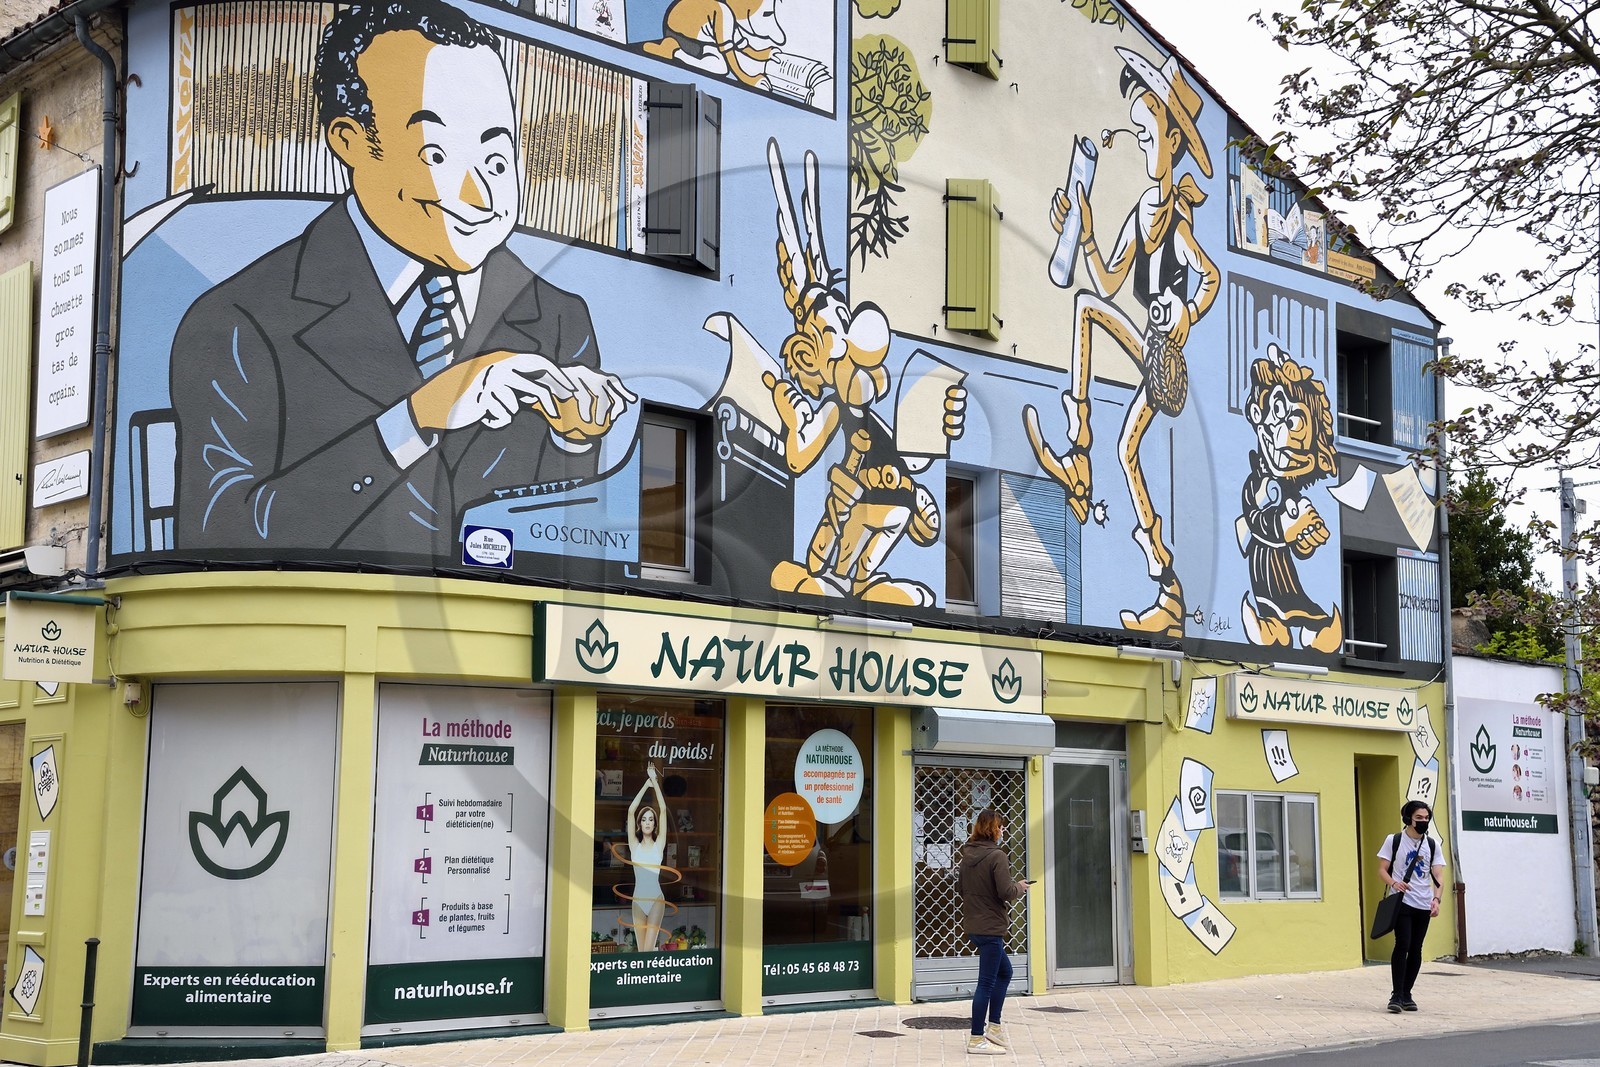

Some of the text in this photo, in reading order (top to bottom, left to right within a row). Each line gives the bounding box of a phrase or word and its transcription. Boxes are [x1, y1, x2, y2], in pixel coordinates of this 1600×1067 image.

[61, 208, 78, 226] Nous
[53, 231, 84, 257] sommes
[53, 262, 83, 288] tous un
[51, 292, 83, 318] chouette
[55, 326, 75, 348] gros
[52, 353, 78, 374] tas de
[48, 384, 79, 405] copains.
[530, 523, 630, 549] GOSCINNY
[483, 543, 506, 551] MICHELET
[14, 644, 87, 656] NATUR HOUSE
[52, 658, 81, 666] Diététique
[650, 631, 969, 698] NATUR HOUSE
[1263, 690, 1390, 720] NATUR HOUSE
[616, 709, 632, 732] je
[634, 712, 675, 733] perds
[1513, 714, 1541, 726] La méthode
[423, 718, 512, 739] La méthode
[1515, 727, 1540, 737] Naturhouse
[428, 747, 509, 763] Naturhouse
[648, 741, 714, 764] du poids!
[806, 754, 852, 765] NATURHOUSE
[803, 770, 856, 779] accompagnée par
[814, 783, 854, 792] professionnel
[439, 799, 503, 808] Suivi hebdomadaire
[826, 795, 842, 804] santé
[421, 808, 430, 818] 1.
[455, 810, 486, 818] par votre
[446, 819, 494, 829] diététicien(ne)
[1484, 815, 1538, 828] naturhouse.fr
[419, 861, 427, 870] 2.
[444, 856, 494, 865] Plan diététique
[447, 866, 491, 874] Personnalisé
[442, 903, 470, 911] Produits
[477, 902, 493, 910] base
[417, 913, 426, 922] 3.
[439, 912, 495, 923] de plantes, fruits
[448, 924, 485, 934] et légumes
[590, 954, 713, 974] xperts en rééducation
[787, 963, 799, 974] 05
[802, 963, 815, 973] 45
[818, 962, 830, 972] 68
[832, 962, 845, 972] 48
[848, 960, 860, 971] 73
[143, 973, 316, 988] Experts en rééducation
[616, 973, 682, 985] alimentaire
[394, 978, 514, 1000] naturhouse.fr
[185, 990, 272, 1003] alimentaire
